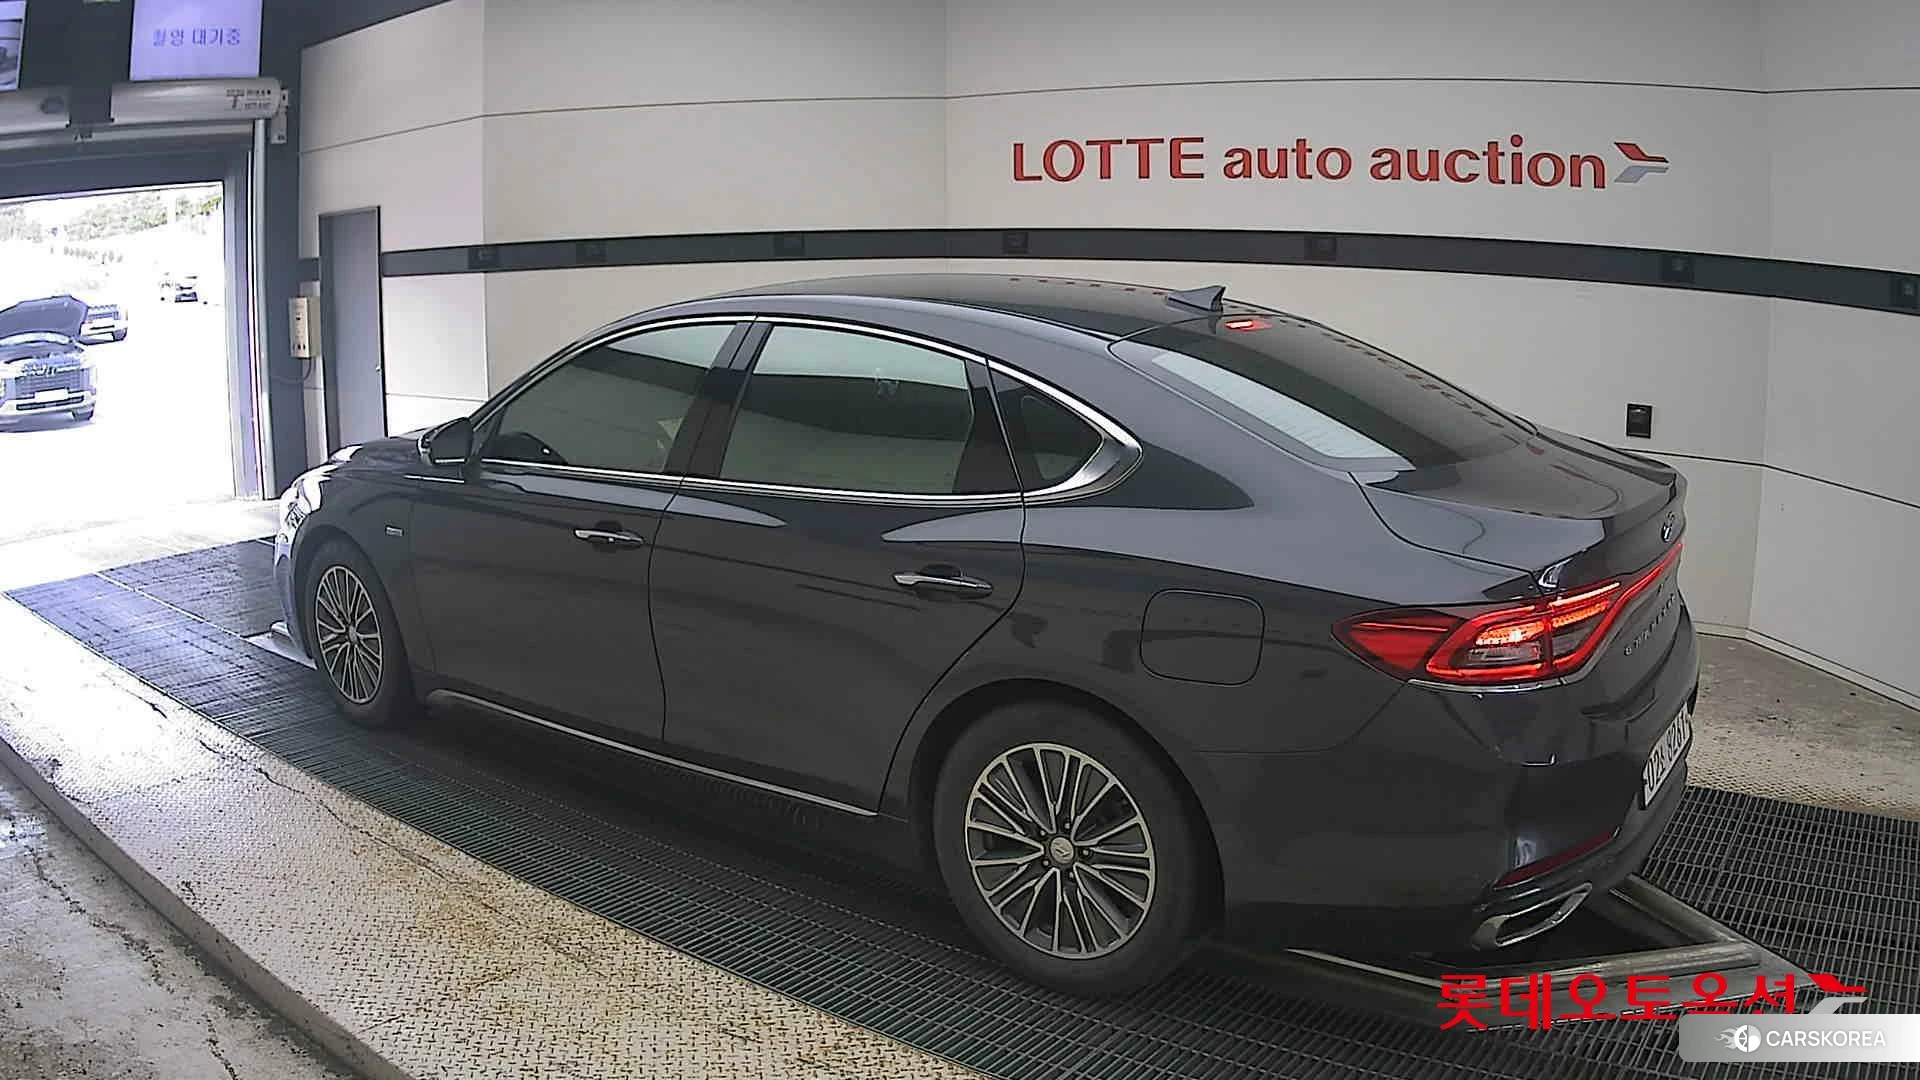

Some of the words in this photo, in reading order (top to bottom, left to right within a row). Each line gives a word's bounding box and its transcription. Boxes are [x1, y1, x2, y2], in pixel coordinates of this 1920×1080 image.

[192, 27, 241, 48] 대기중
[1013, 136, 1205, 182] LOTTE
[1223, 138, 1352, 180] auto
[1369, 135, 1607, 189] auction
